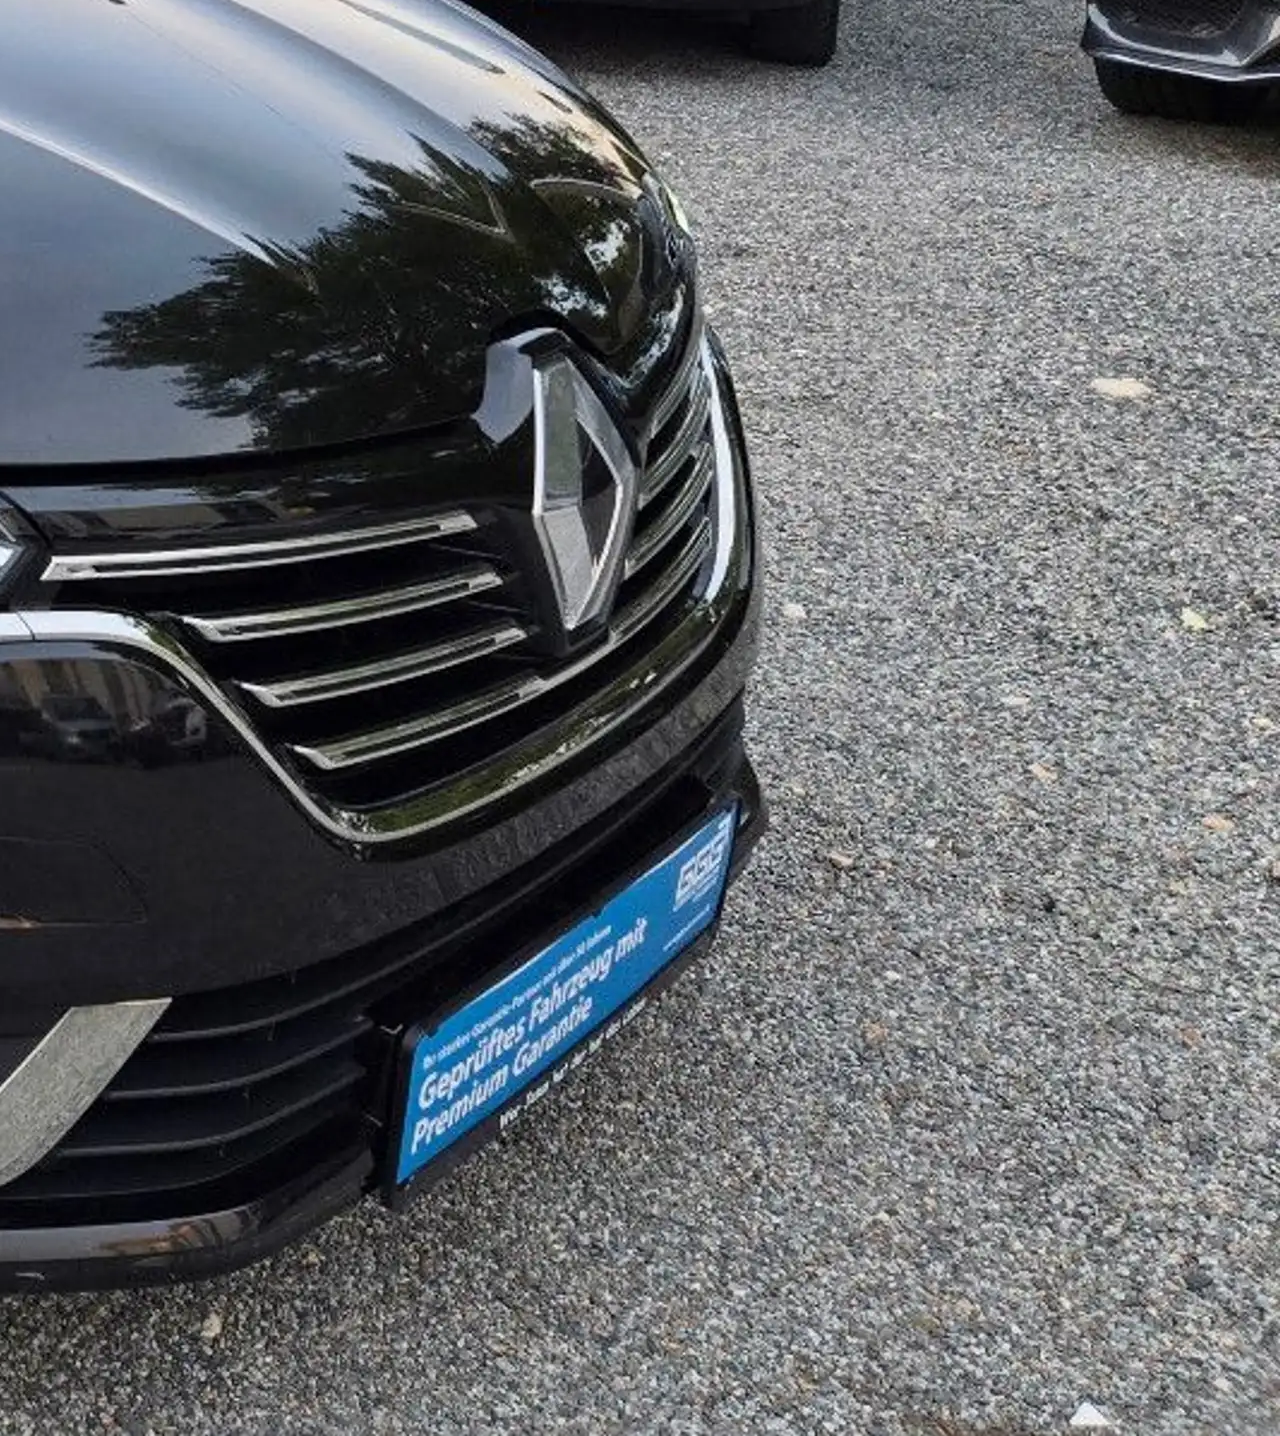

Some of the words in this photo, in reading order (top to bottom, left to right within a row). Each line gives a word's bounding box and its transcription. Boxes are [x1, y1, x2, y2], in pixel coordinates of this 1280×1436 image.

[411, 1064, 508, 1155] Premium
[512, 996, 593, 1077] Garantie
[418, 1016, 525, 1110] Geprüftes
[529, 946, 614, 1032] Fahrzeug
[615, 917, 648, 963] mit
